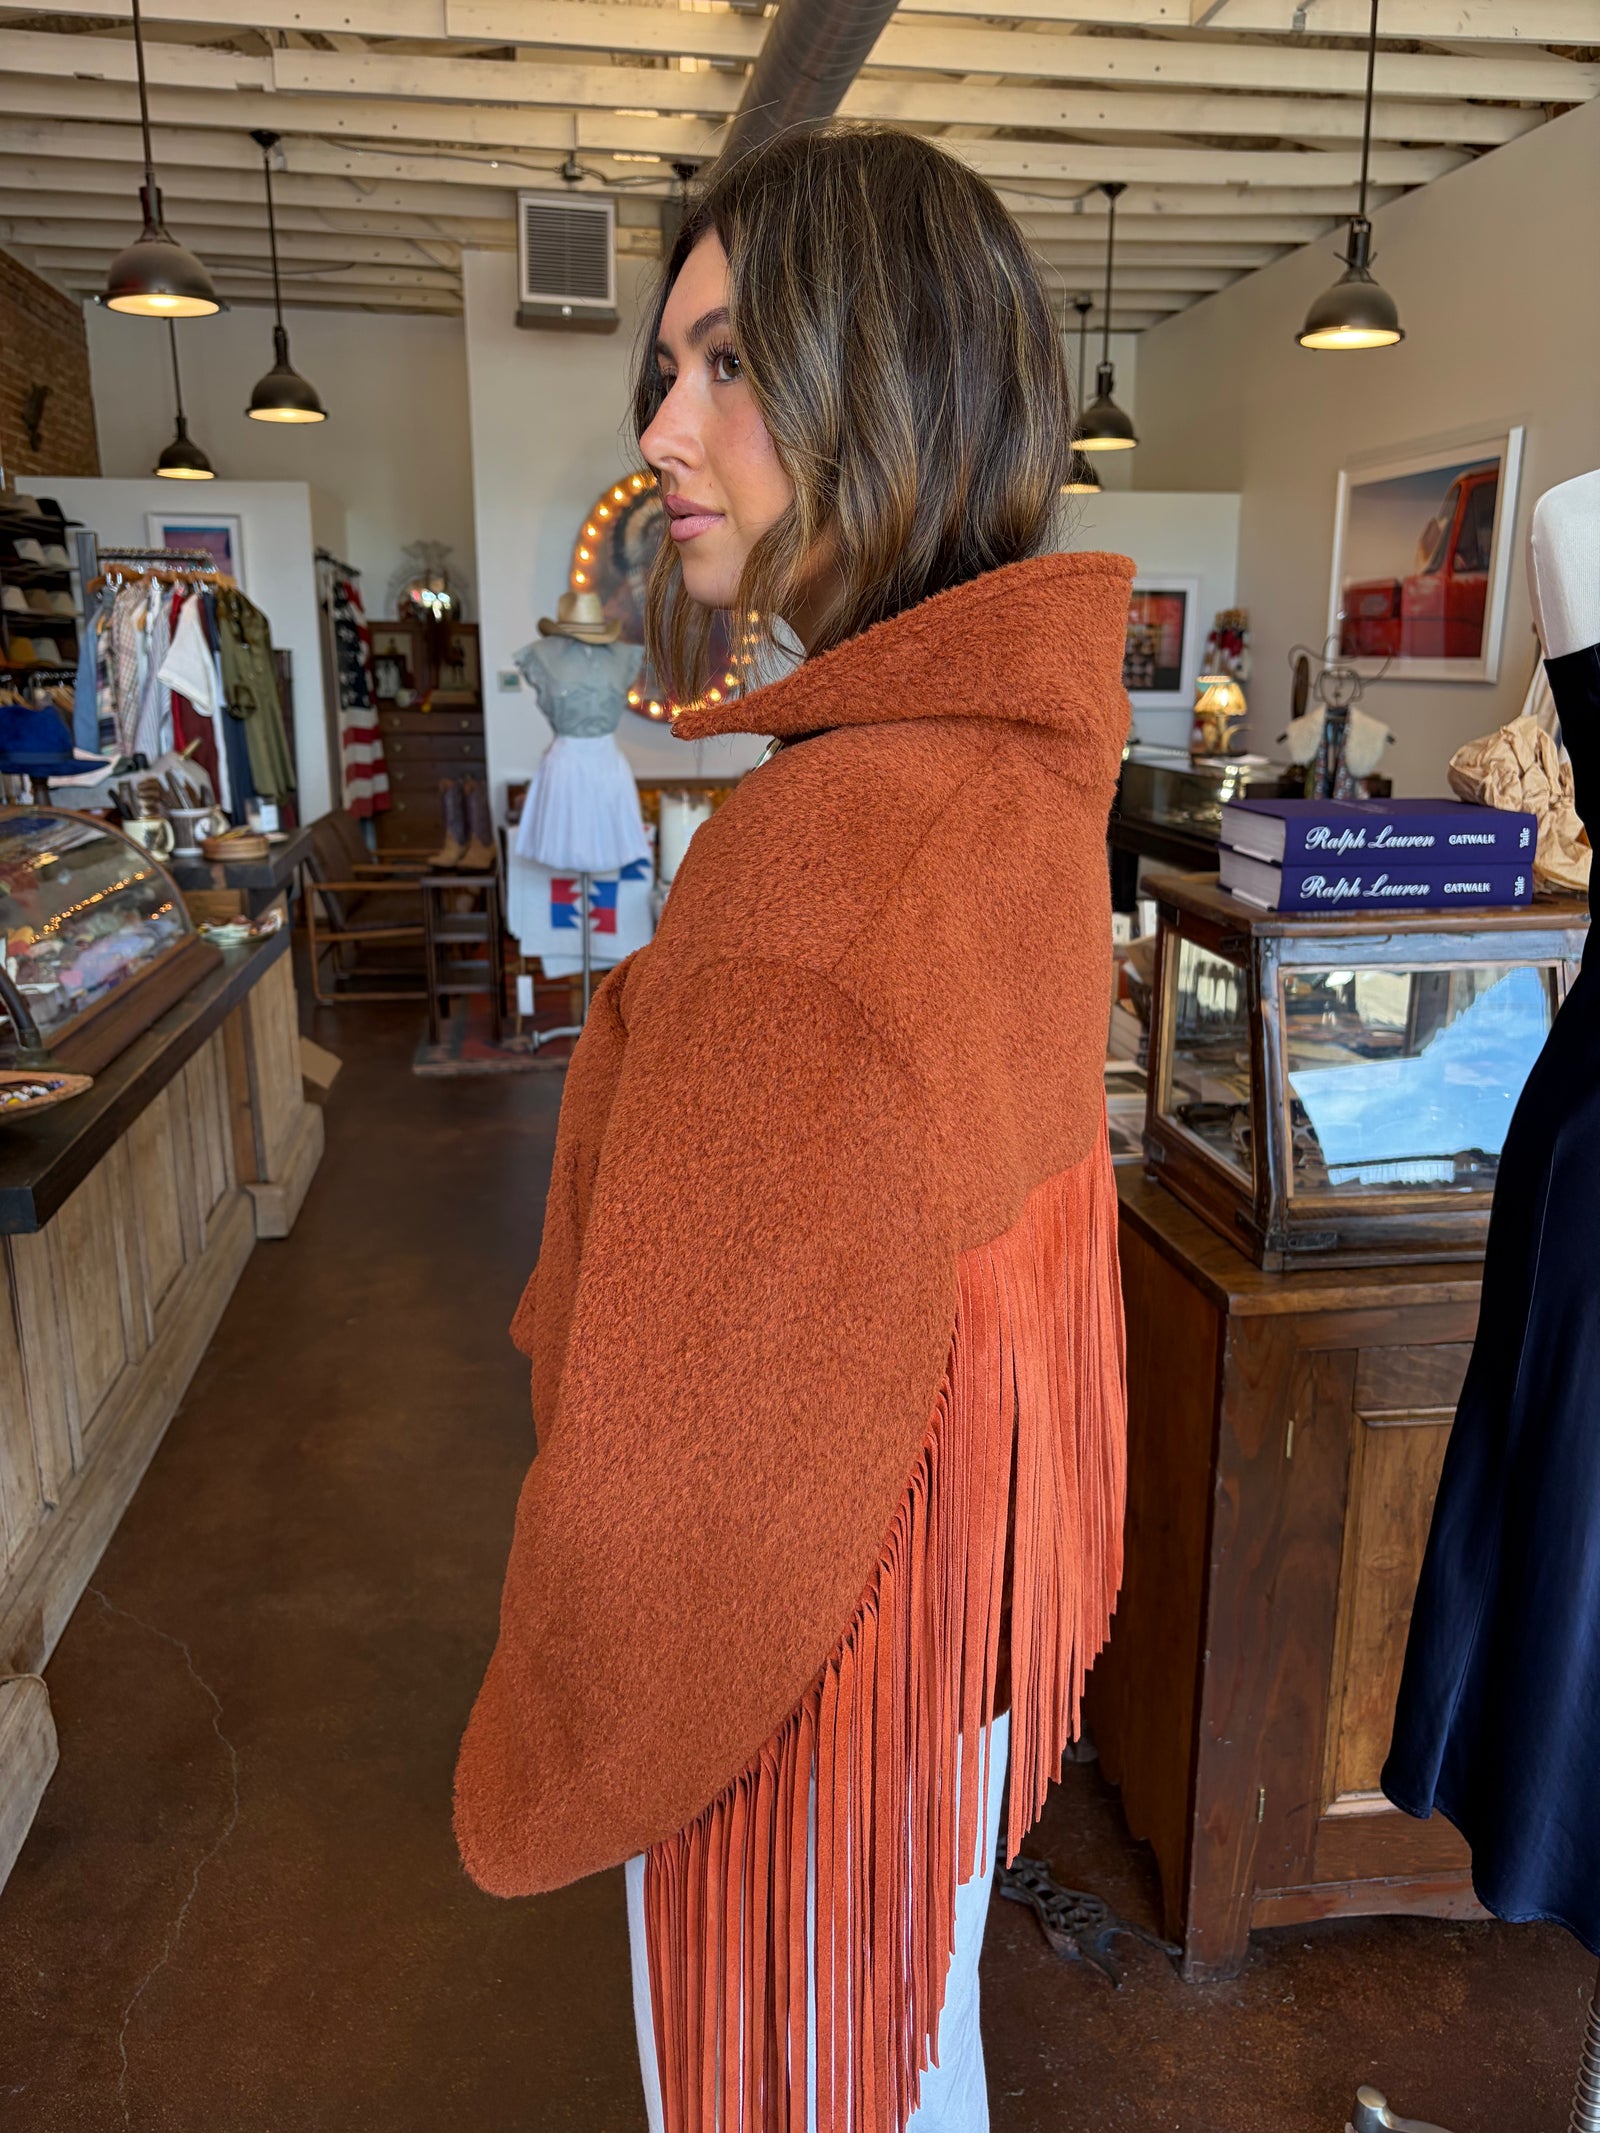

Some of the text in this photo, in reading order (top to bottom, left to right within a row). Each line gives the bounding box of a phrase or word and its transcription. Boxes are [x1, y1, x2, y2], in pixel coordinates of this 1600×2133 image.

[1305, 825, 1496, 857] Ralph Lauren CATWALK
[1300, 873, 1491, 905] Ralph Lauren CATWALK
